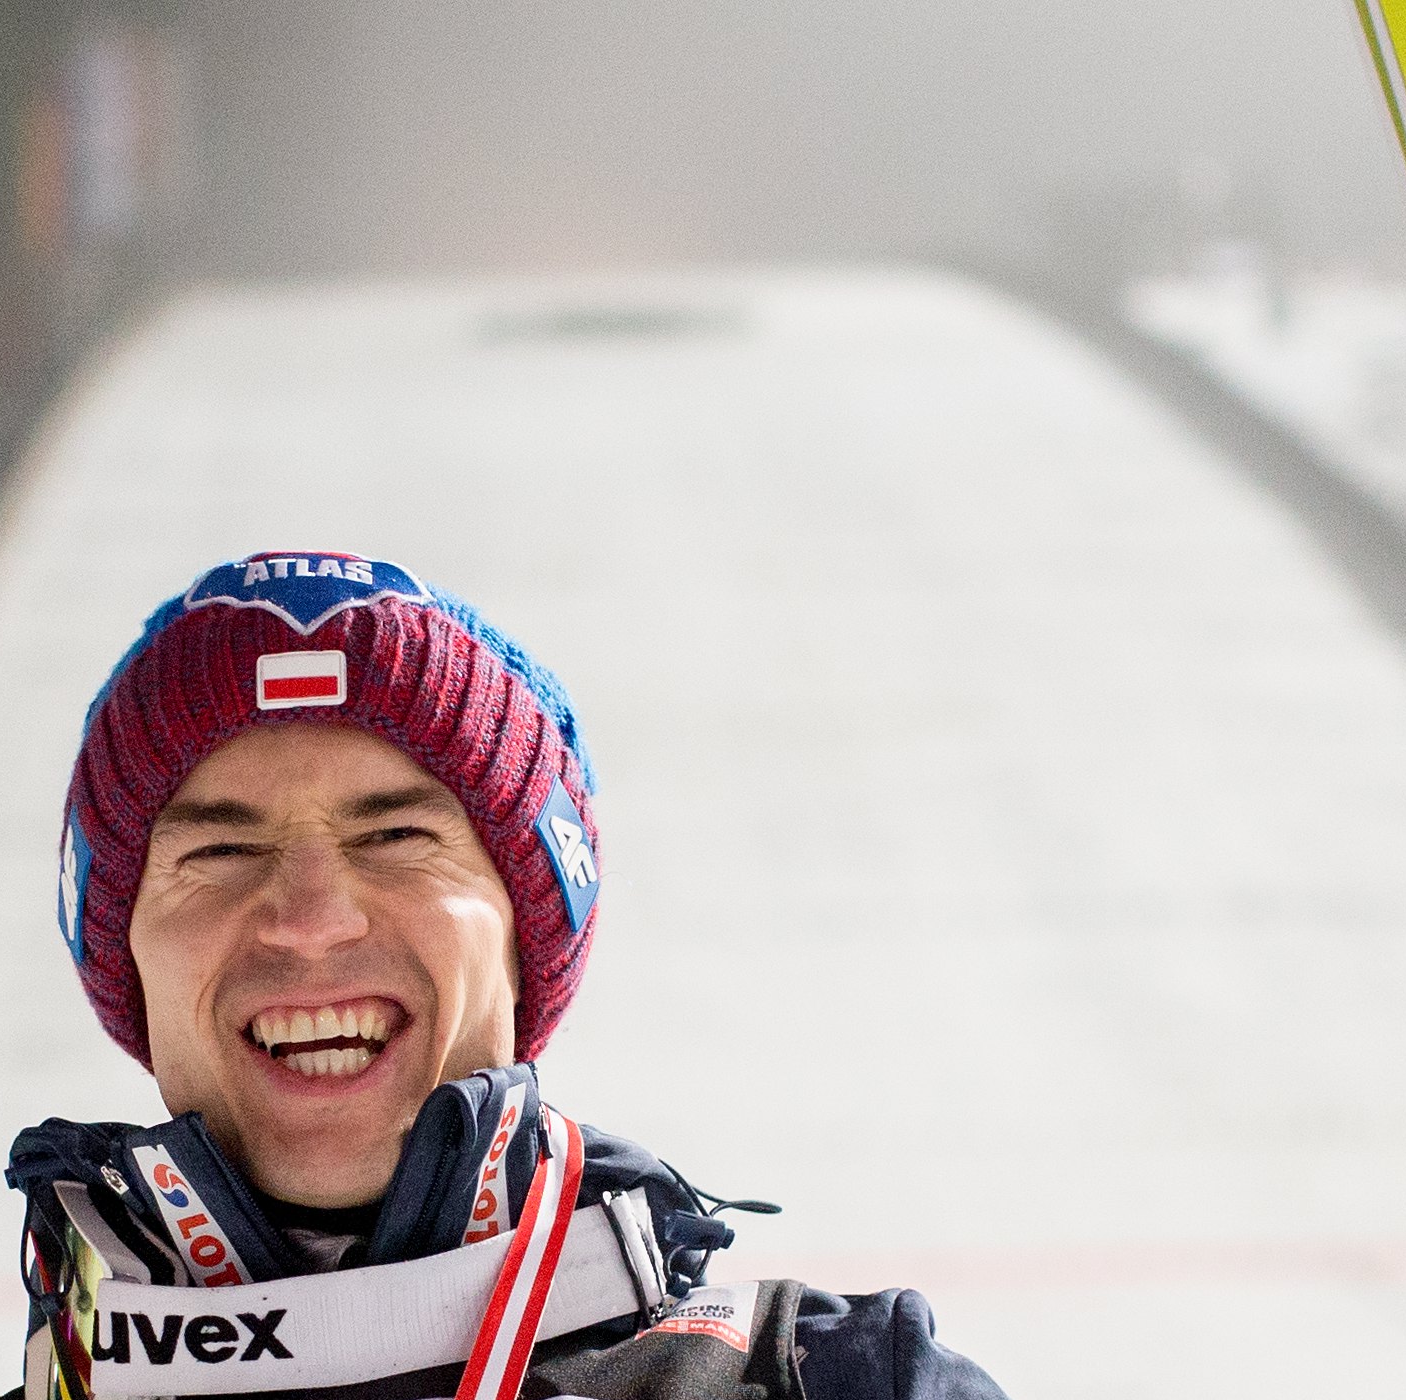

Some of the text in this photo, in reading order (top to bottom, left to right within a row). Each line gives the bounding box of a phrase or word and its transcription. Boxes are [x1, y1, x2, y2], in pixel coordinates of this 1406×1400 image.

[244, 558, 373, 587] ATLAS
[463, 1105, 517, 1244] LOTOS
[91, 1308, 294, 1365] uvex
